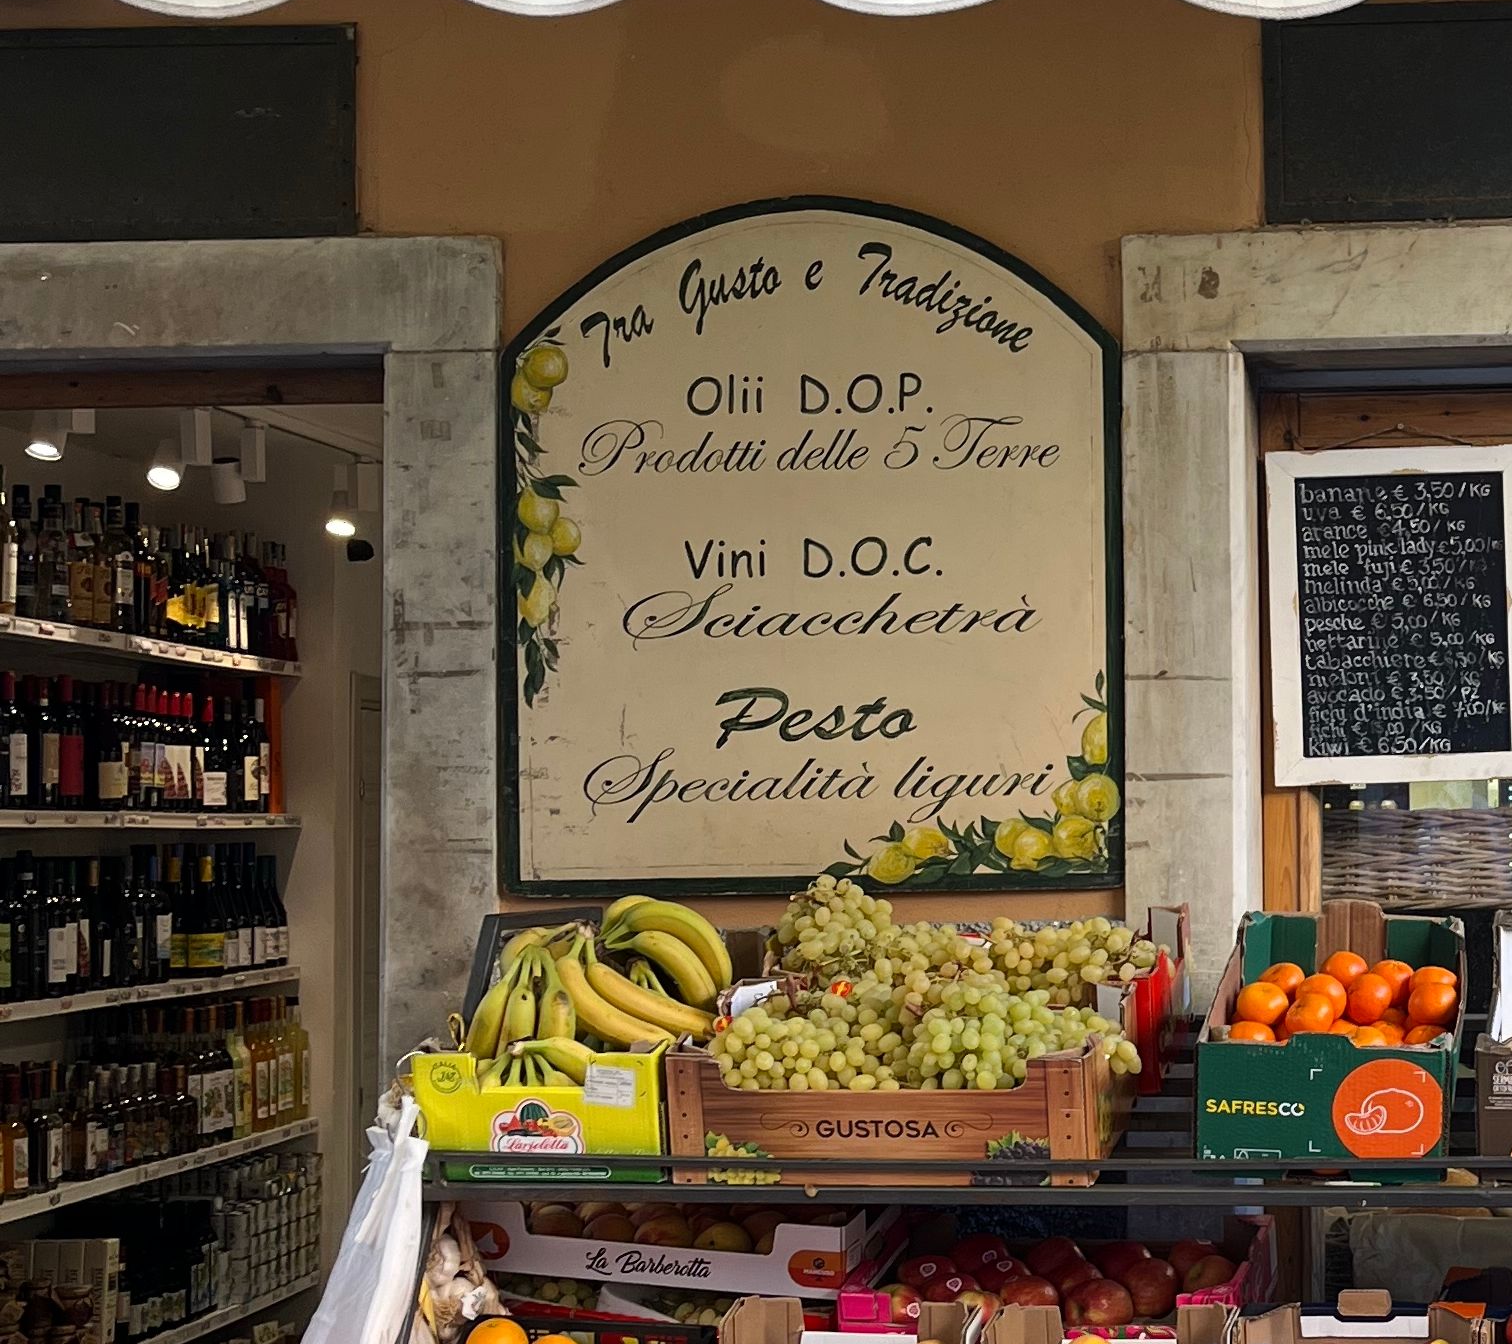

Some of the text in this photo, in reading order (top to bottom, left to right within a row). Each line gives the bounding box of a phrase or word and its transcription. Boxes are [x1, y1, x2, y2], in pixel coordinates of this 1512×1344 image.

[580, 242, 1035, 367] Tra Gusto e Tradizione
[686, 372, 935, 416] Olii D.O.P.
[578, 416, 1061, 477] Prodotti delle 5 Terre
[1303, 506, 1342, 522] uva
[1302, 524, 1368, 543] arance
[684, 536, 944, 580] Vini D.O.C.
[1303, 536, 1435, 565] mele pink lady
[1303, 557, 1398, 580] mele fuji
[1304, 576, 1384, 595] melinda
[1303, 594, 1395, 614] albicocche
[622, 584, 1044, 651] Sciacchetrà
[1304, 613, 1366, 637] pesche
[1305, 651, 1427, 670] tabacchiere
[1307, 687, 1386, 704] avocado
[715, 687, 919, 749] Pesto
[1308, 737, 1350, 757] kiwi
[582, 748, 1054, 824] Specialità liguri
[1205, 1098, 1306, 1117] SAFRESCO
[815, 1119, 940, 1138] GUSTOSA
[586, 1247, 712, 1279] La Barberotta
